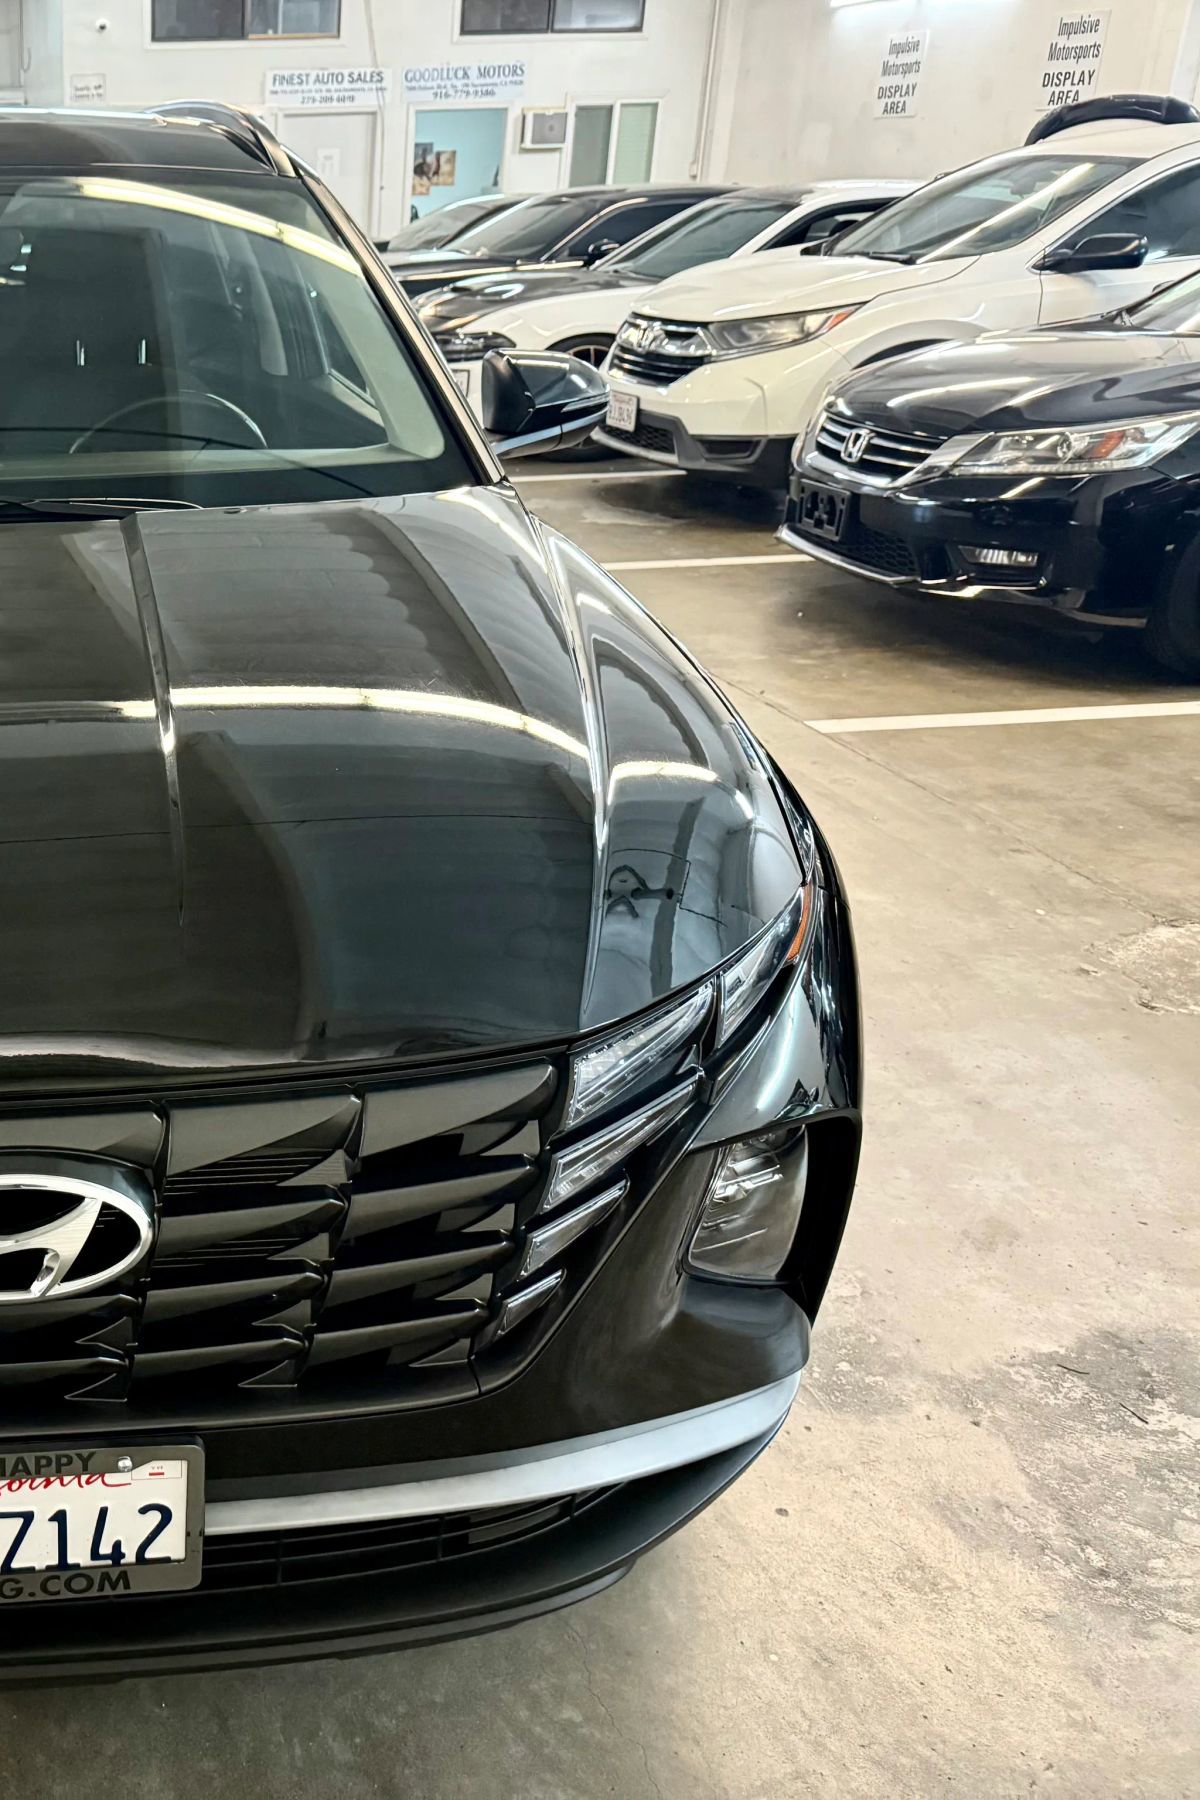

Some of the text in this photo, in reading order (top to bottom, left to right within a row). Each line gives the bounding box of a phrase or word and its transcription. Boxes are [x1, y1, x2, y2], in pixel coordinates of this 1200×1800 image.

[1058, 14, 1100, 40] Impulsive
[888, 36, 920, 59] Impulsive
[1047, 41, 1101, 64] Motorsports
[404, 63, 525, 82] GOODLUCK MOTORS
[881, 59, 921, 78] Motorsports
[272, 70, 384, 87] FINEST AUTO SALES
[1042, 69, 1095, 88] DISPLAY
[877, 82, 917, 100] DISPLAY
[1047, 89, 1079, 106] AREA
[882, 100, 906, 115] AREA
